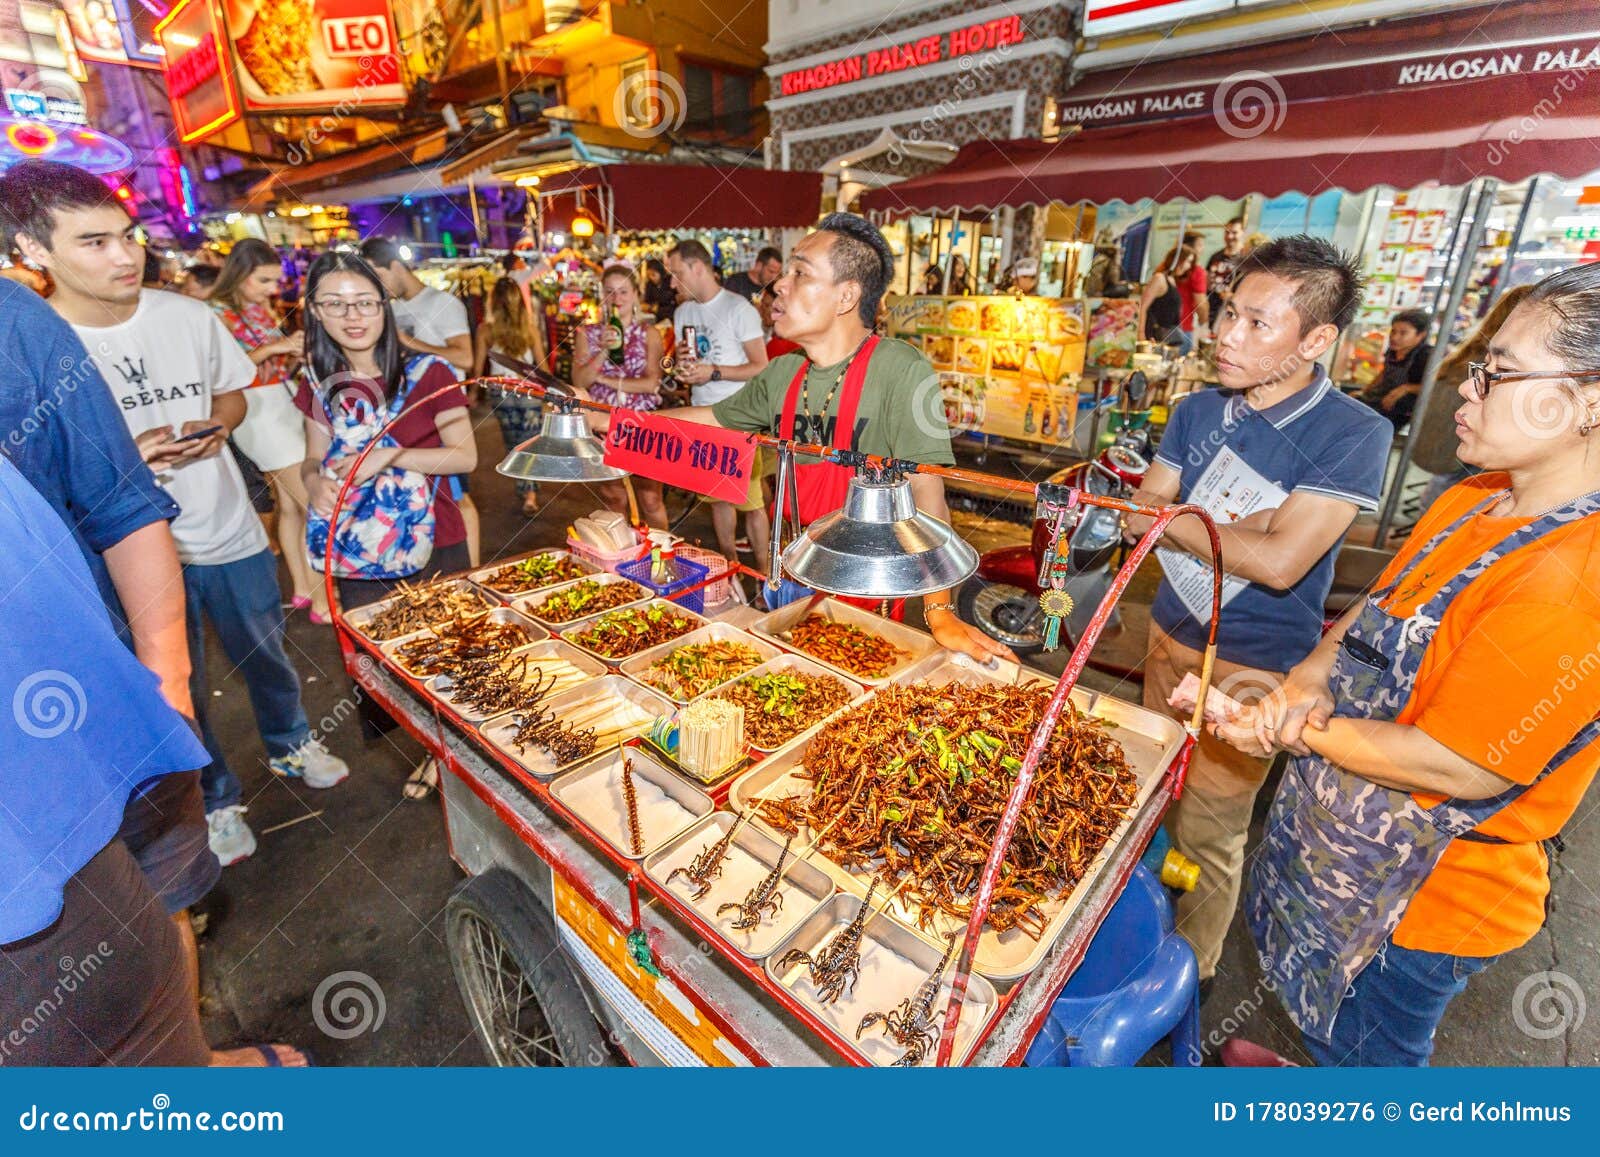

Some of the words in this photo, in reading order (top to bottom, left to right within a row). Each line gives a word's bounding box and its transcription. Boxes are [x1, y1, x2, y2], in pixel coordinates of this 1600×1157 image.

[328, 22, 384, 52] LEO
[781, 55, 862, 96] KHAOSAN
[867, 34, 943, 77] PALACE
[950, 14, 1025, 58] HOTEL
[1397, 53, 1523, 85] KHAOSAN
[1062, 100, 1136, 122] KHAOSAN
[1142, 90, 1207, 113] PALACE
[613, 422, 683, 463] PHOTO
